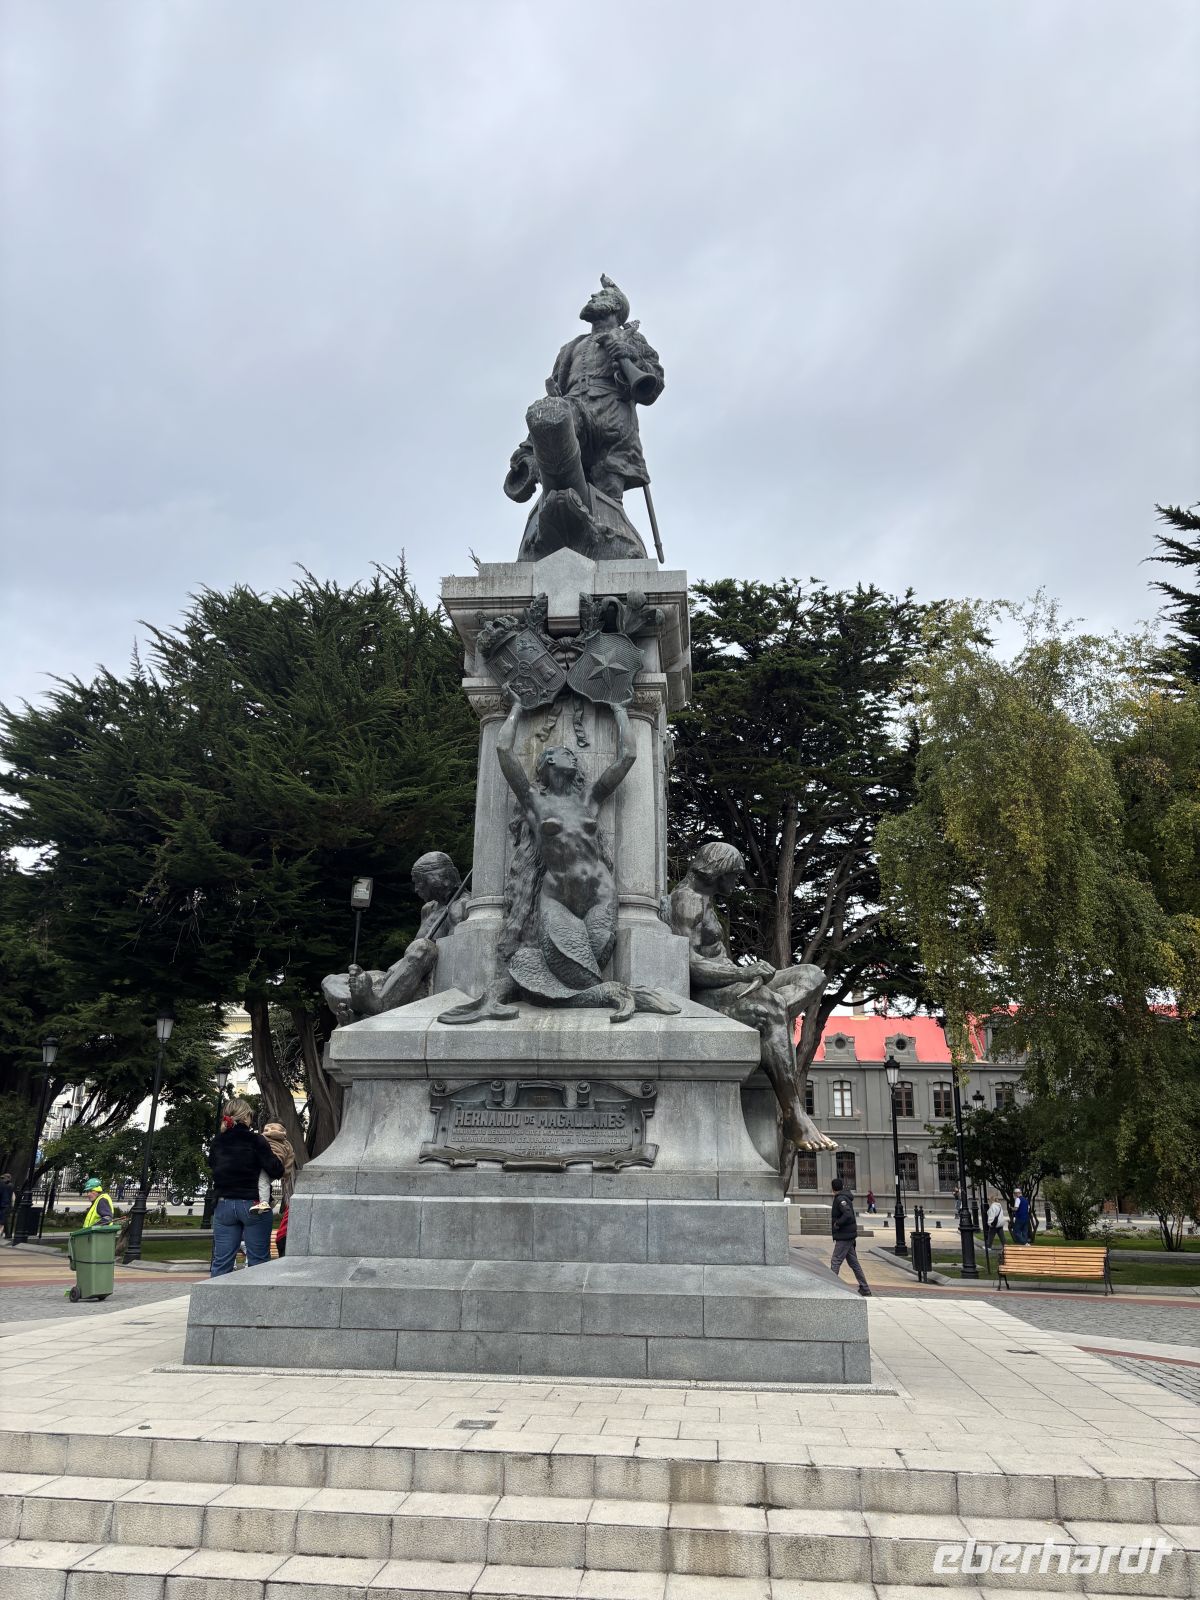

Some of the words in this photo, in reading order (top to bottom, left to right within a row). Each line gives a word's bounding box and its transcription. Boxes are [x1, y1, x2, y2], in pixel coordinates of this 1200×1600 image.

[455, 1111, 520, 1127] HERNANDO
[524, 1114, 535, 1125] DE
[538, 1112, 626, 1129] MAGALLANES
